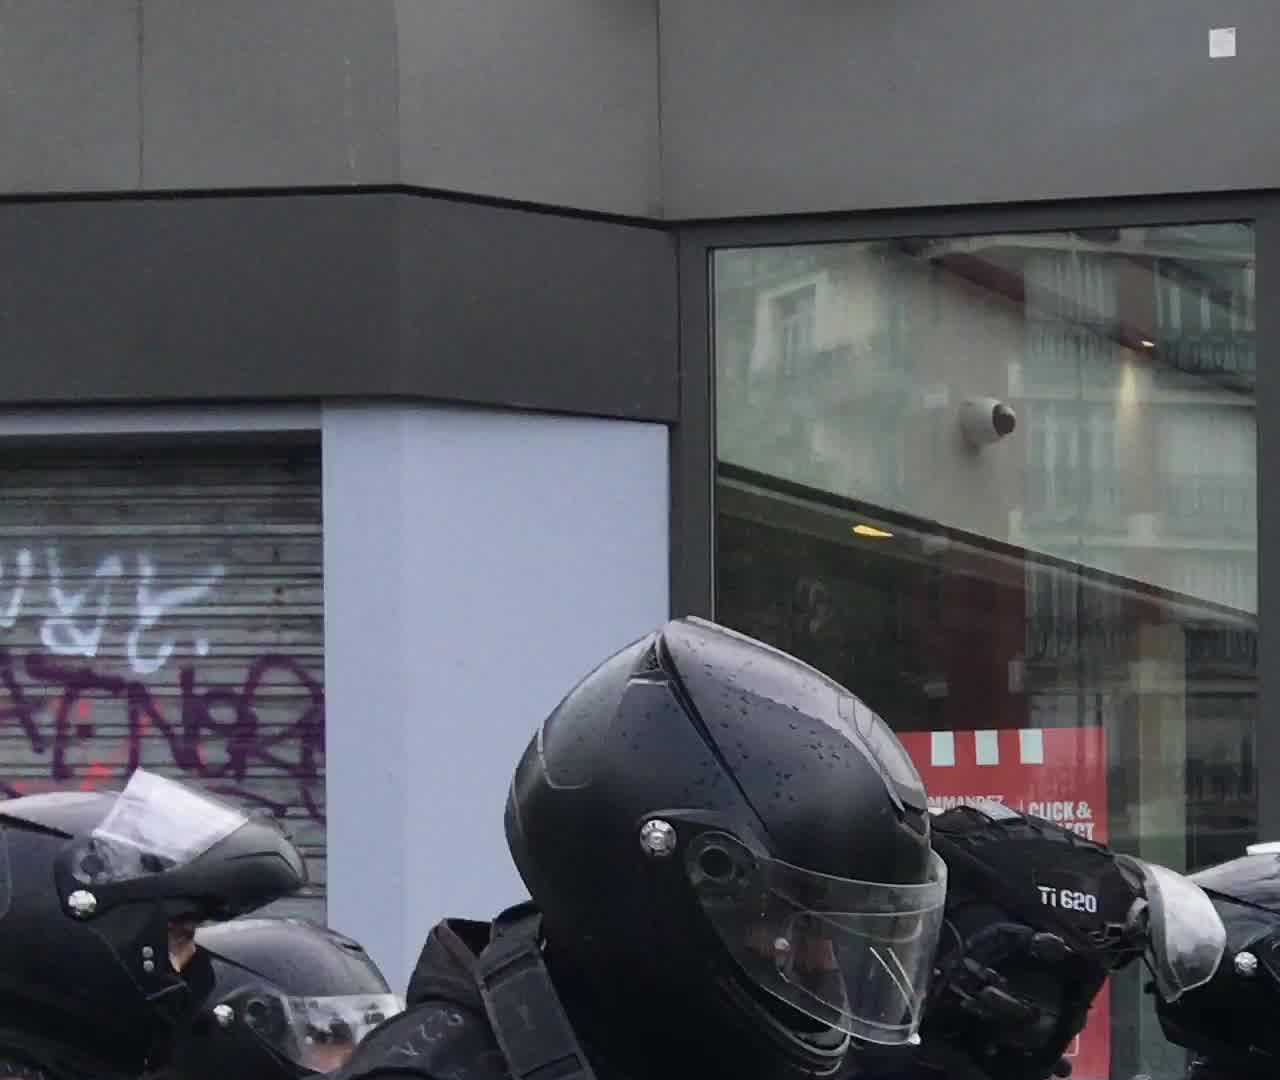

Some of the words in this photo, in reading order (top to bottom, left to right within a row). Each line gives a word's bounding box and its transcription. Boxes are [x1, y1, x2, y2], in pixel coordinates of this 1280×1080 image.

[1076, 801, 1092, 819] &
[1037, 885, 1057, 908] Ti
[1059, 888, 1097, 913] 620
